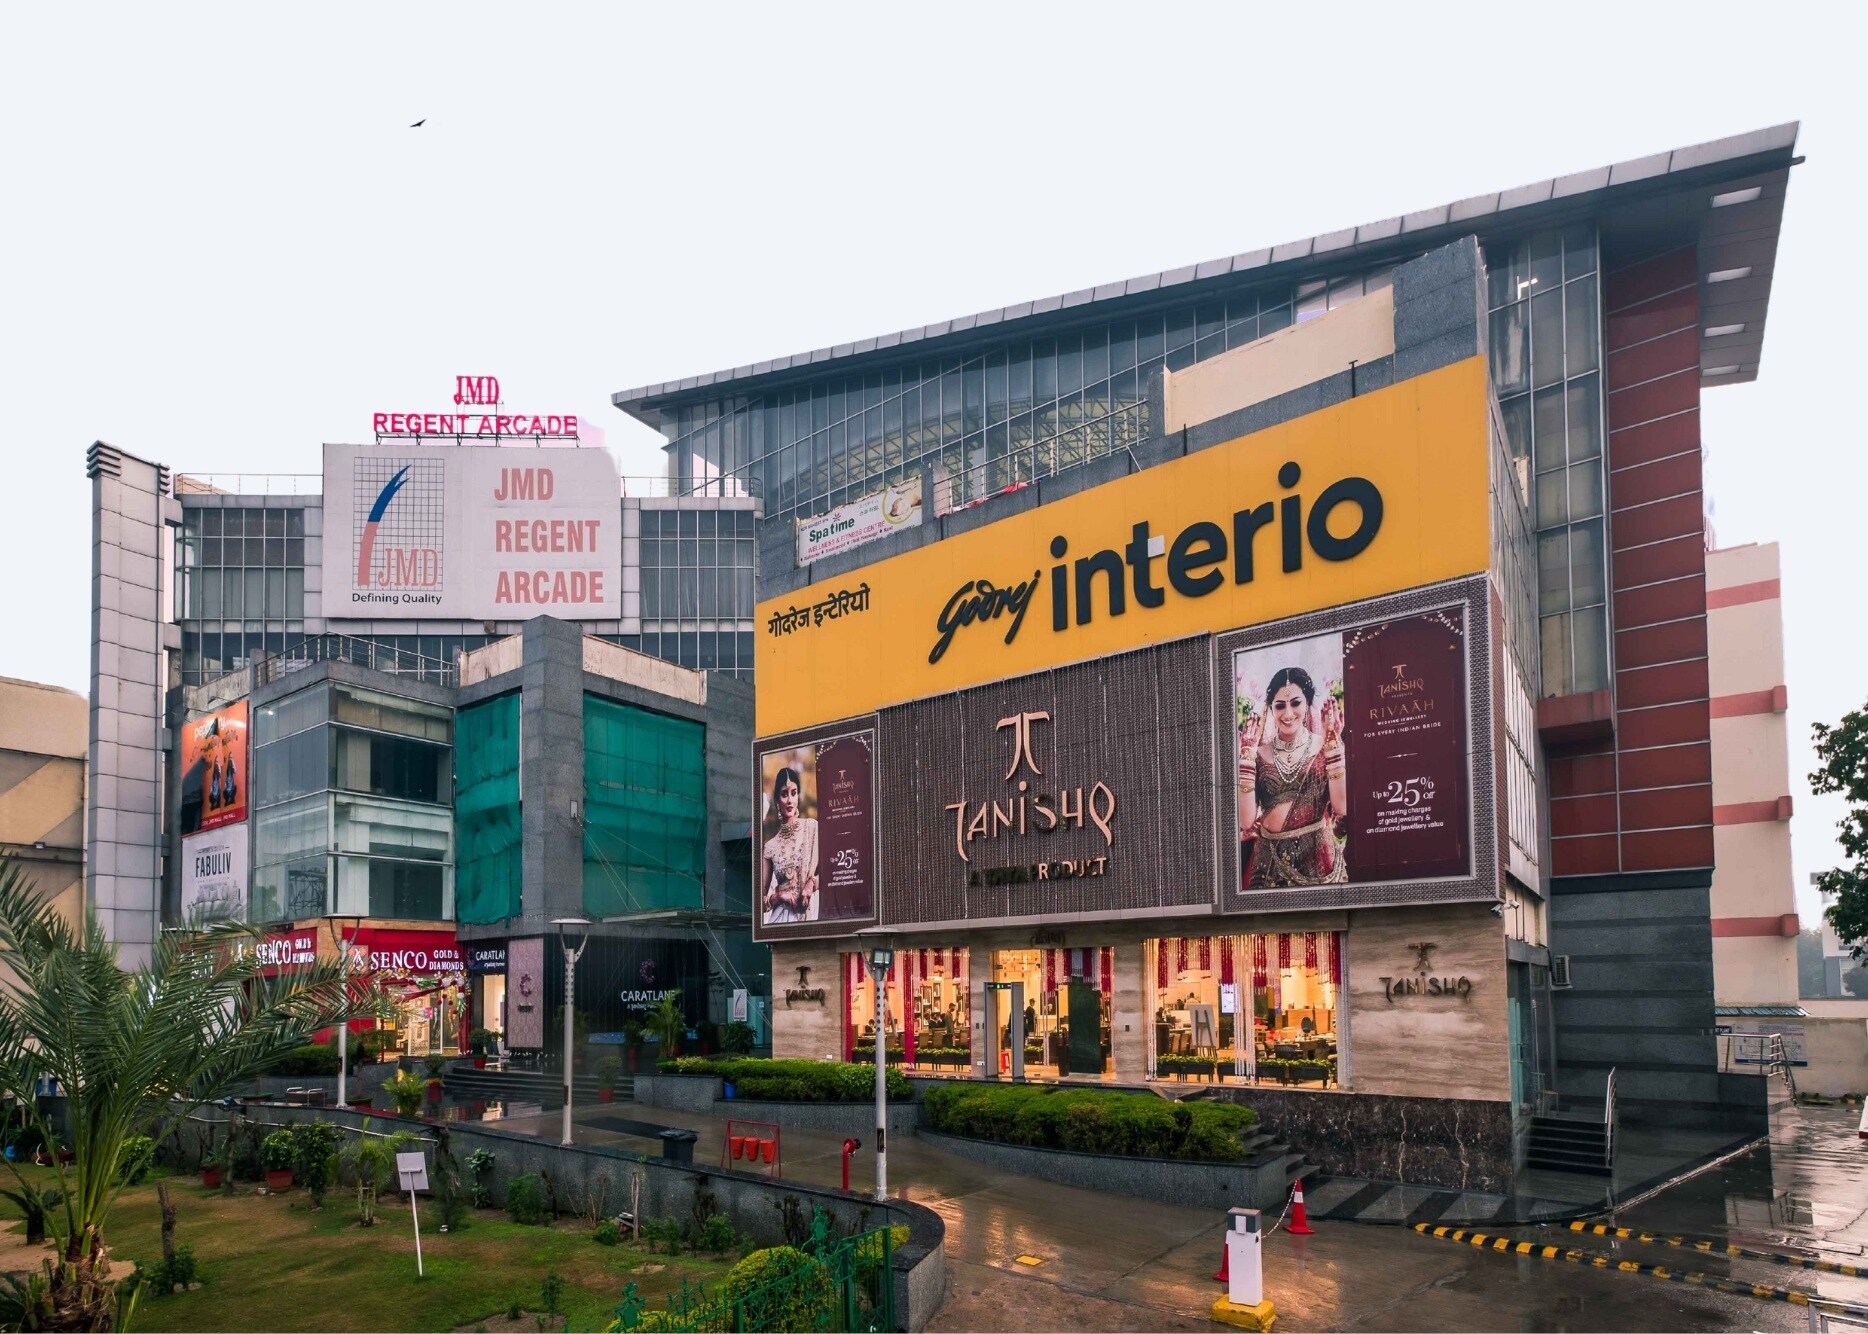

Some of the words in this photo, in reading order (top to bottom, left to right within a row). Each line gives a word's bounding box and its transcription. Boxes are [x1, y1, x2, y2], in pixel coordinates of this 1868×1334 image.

[453, 375, 500, 405] JMD
[373, 412, 469, 434] REGENT
[478, 414, 578, 436] ARCADE
[494, 467, 555, 501] JMD
[495, 520, 600, 553] REGENT
[841, 528, 863, 542] FITNESS
[863, 520, 885, 534] CENTRE
[1050, 461, 1384, 632] interio
[377, 548, 439, 587] JMD
[352, 593, 399, 605] Defining
[402, 593, 442, 605] Quality
[494, 571, 604, 604] ARCADE
[768, 604, 811, 637] गोदरेज
[813, 582, 870, 627] इन्टेरियो
[1377, 729, 1396, 737] EVERY
[1422, 721, 1442, 730] BRIDE
[1372, 791, 1382, 800] Up
[1383, 790, 1390, 798] to
[1388, 776, 1435, 807] 25%
[1422, 790, 1436, 800] Off
[1377, 810, 1385, 818] on
[1385, 808, 1408, 816] making
[1408, 806, 1432, 815] charges
[1384, 817, 1398, 826] gold
[1398, 814, 1424, 824] jewellery
[1374, 825, 1401, 833] diamond
[1401, 822, 1427, 832] jewellery
[1427, 820, 1444, 828] value
[195, 852, 232, 878] FABULIV
[255, 940, 292, 969] SENCO
[370, 950, 428, 970] SENCO
[433, 950, 453, 959] GOLD
[453, 949, 459, 959] &
[429, 961, 464, 971] DIAMONDS
